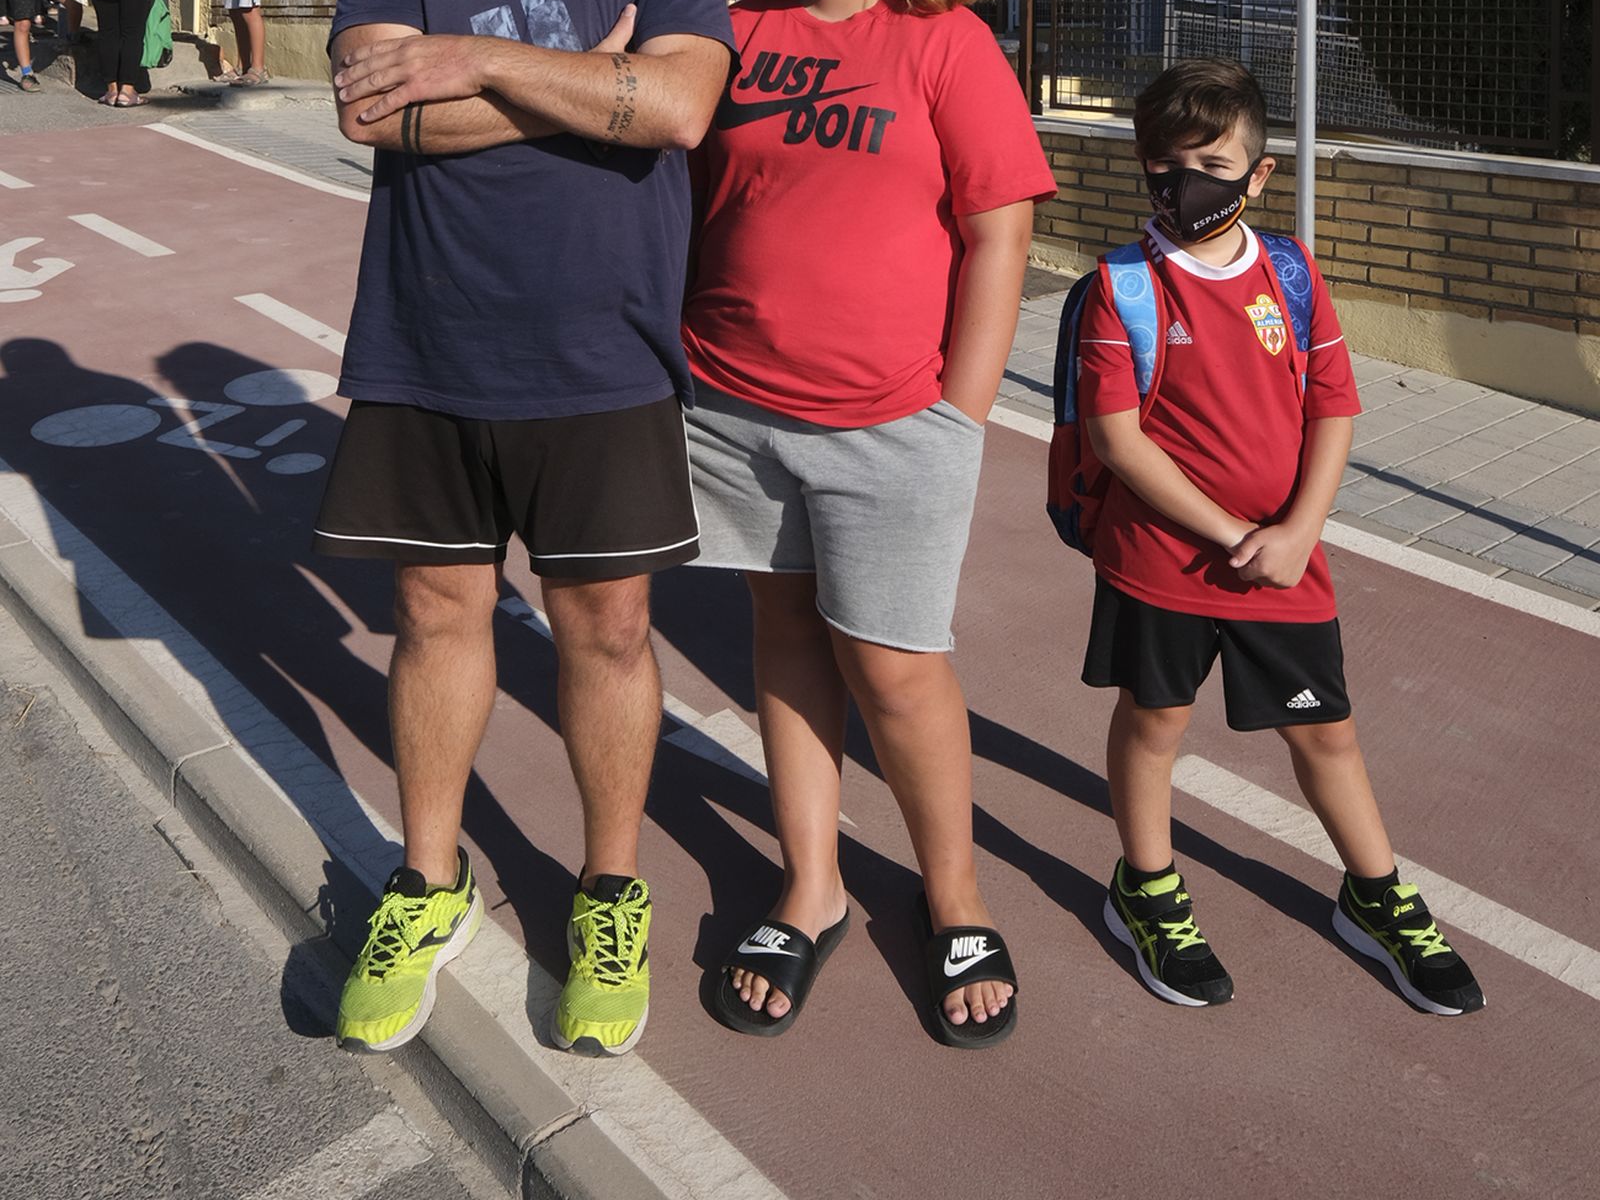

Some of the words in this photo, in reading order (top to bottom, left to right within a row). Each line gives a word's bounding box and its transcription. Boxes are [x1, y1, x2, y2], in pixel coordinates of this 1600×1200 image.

[737, 51, 841, 98] JUST
[1286, 699, 1321, 709] adidas
[750, 925, 791, 951] NIKE
[950, 935, 988, 960] NIKE
